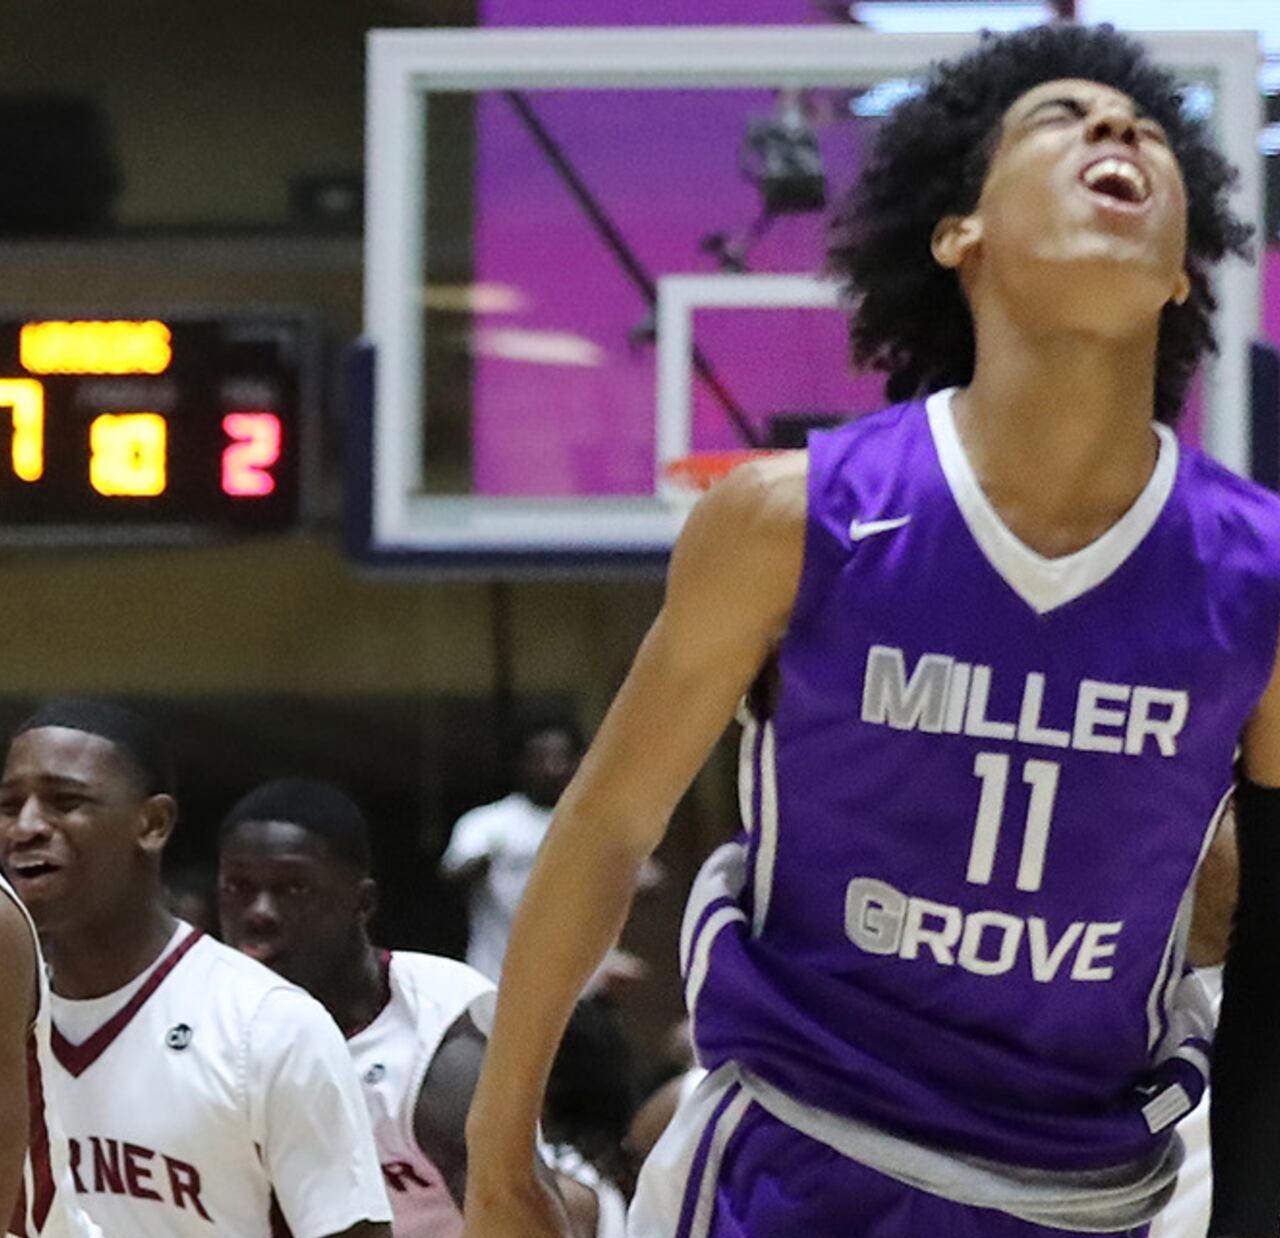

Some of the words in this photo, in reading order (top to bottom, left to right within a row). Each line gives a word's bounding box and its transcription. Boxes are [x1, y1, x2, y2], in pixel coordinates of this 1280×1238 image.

[222, 413, 281, 496] 2
[861, 644, 1189, 757] MILLER
[966, 751, 1061, 892] 11
[843, 876, 1123, 983] GROVE
